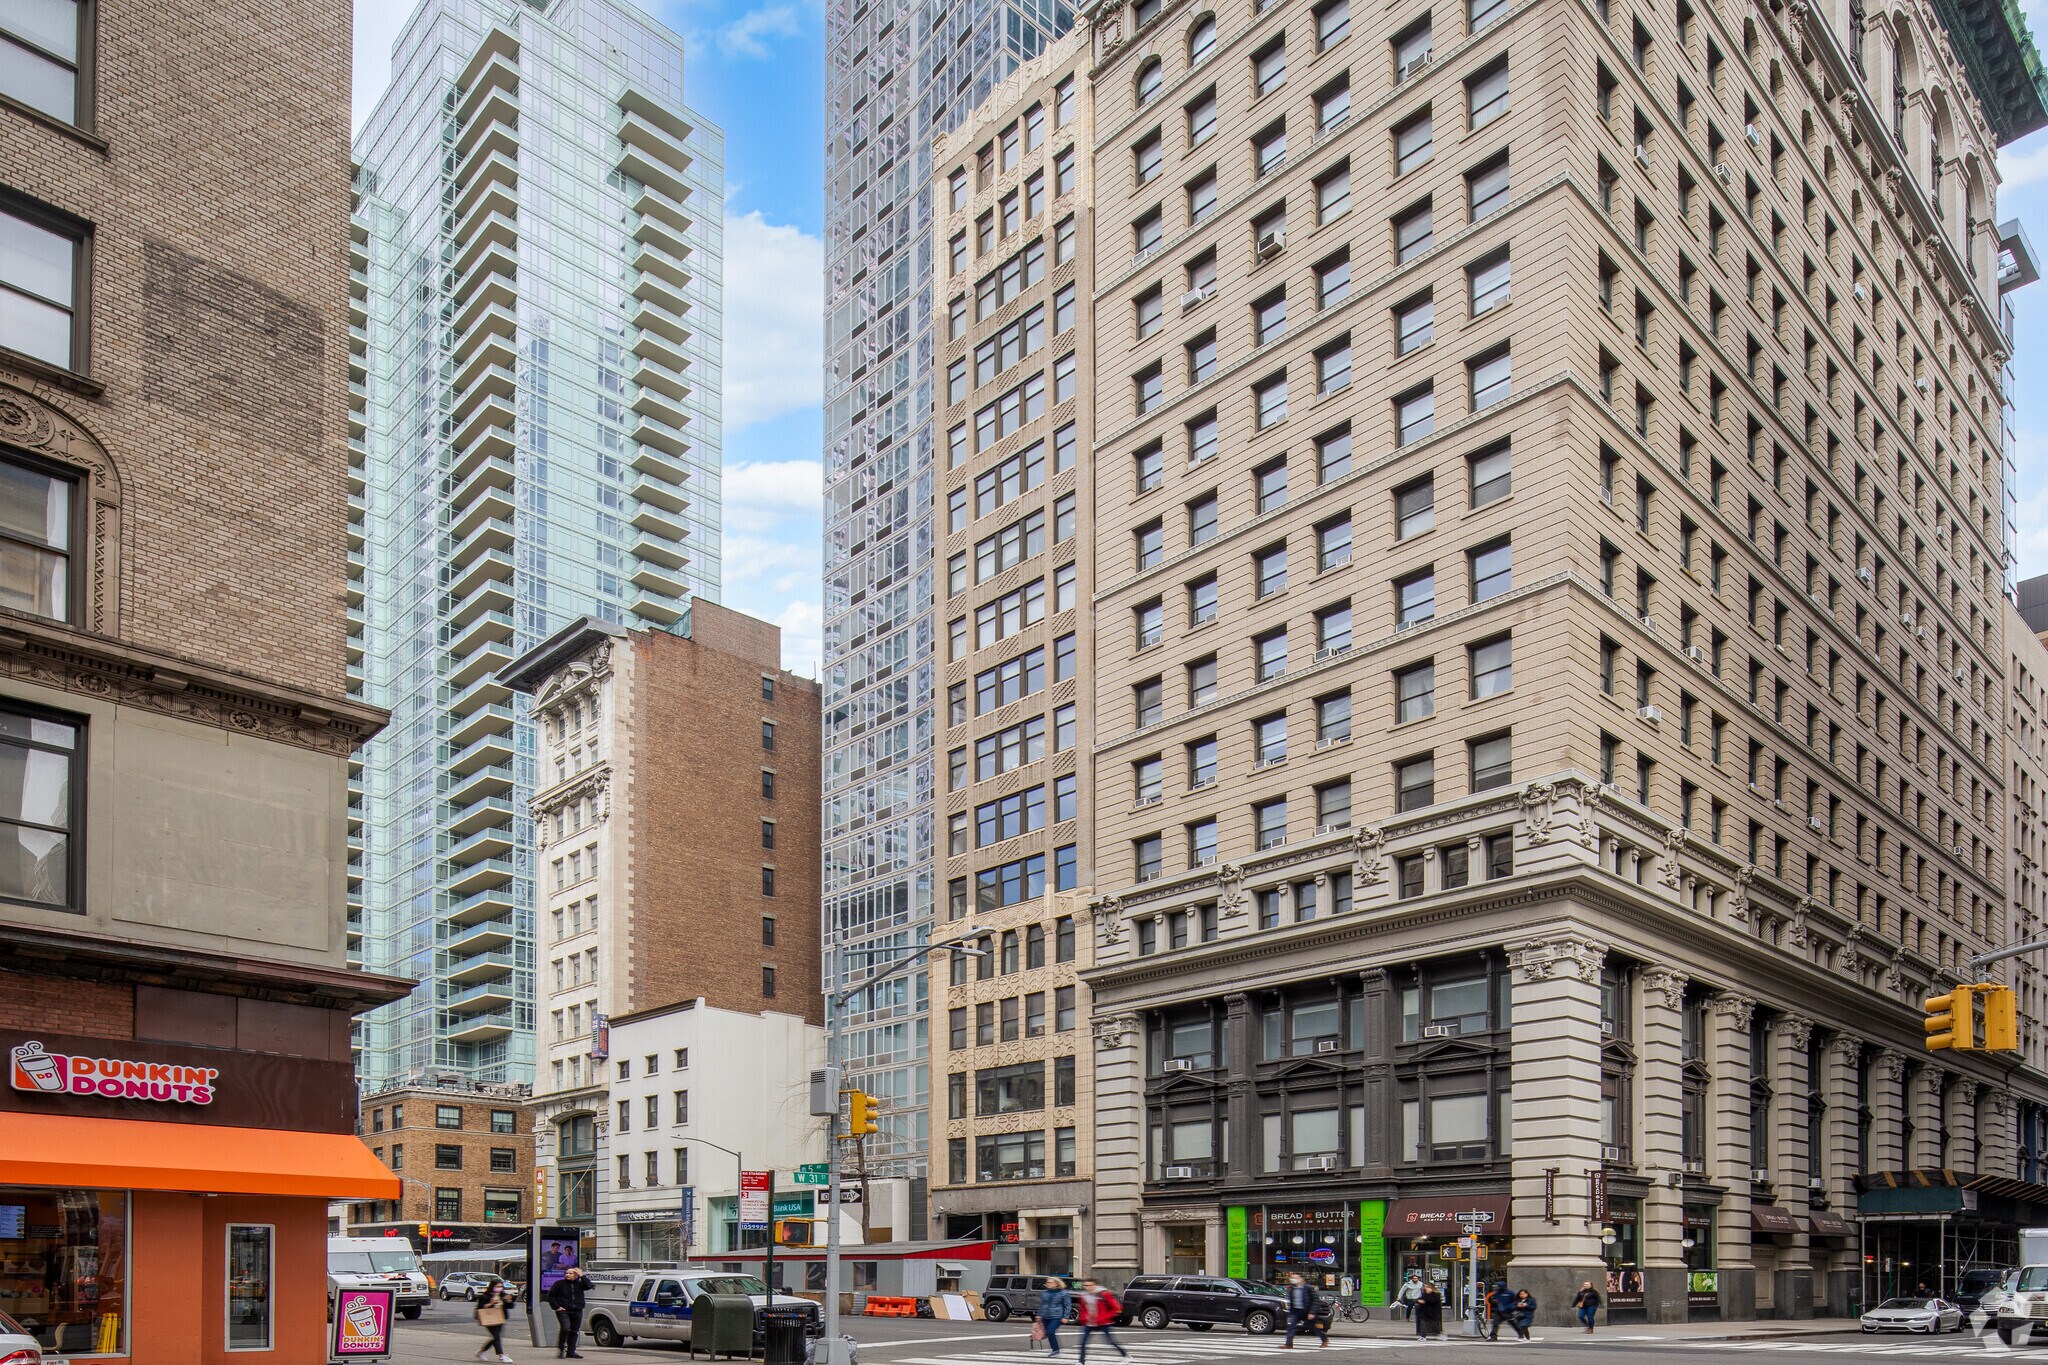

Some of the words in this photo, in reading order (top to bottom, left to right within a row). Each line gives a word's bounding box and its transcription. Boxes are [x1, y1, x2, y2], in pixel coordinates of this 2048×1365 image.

[72, 1057, 216, 1085] DUNKIN'
[36, 1072, 53, 1080] DD
[72, 1076, 211, 1104] DONUTS
[808, 1165, 813, 1173] 5
[797, 1173, 805, 1182] W
[809, 1174, 818, 1183] 31
[773, 1204, 788, 1212] Bank
[788, 1203, 801, 1211] USA
[1271, 1212, 1303, 1220] BREAD
[1001, 1223, 1019, 1232] LET'
[1000, 1234, 1019, 1242] MEA
